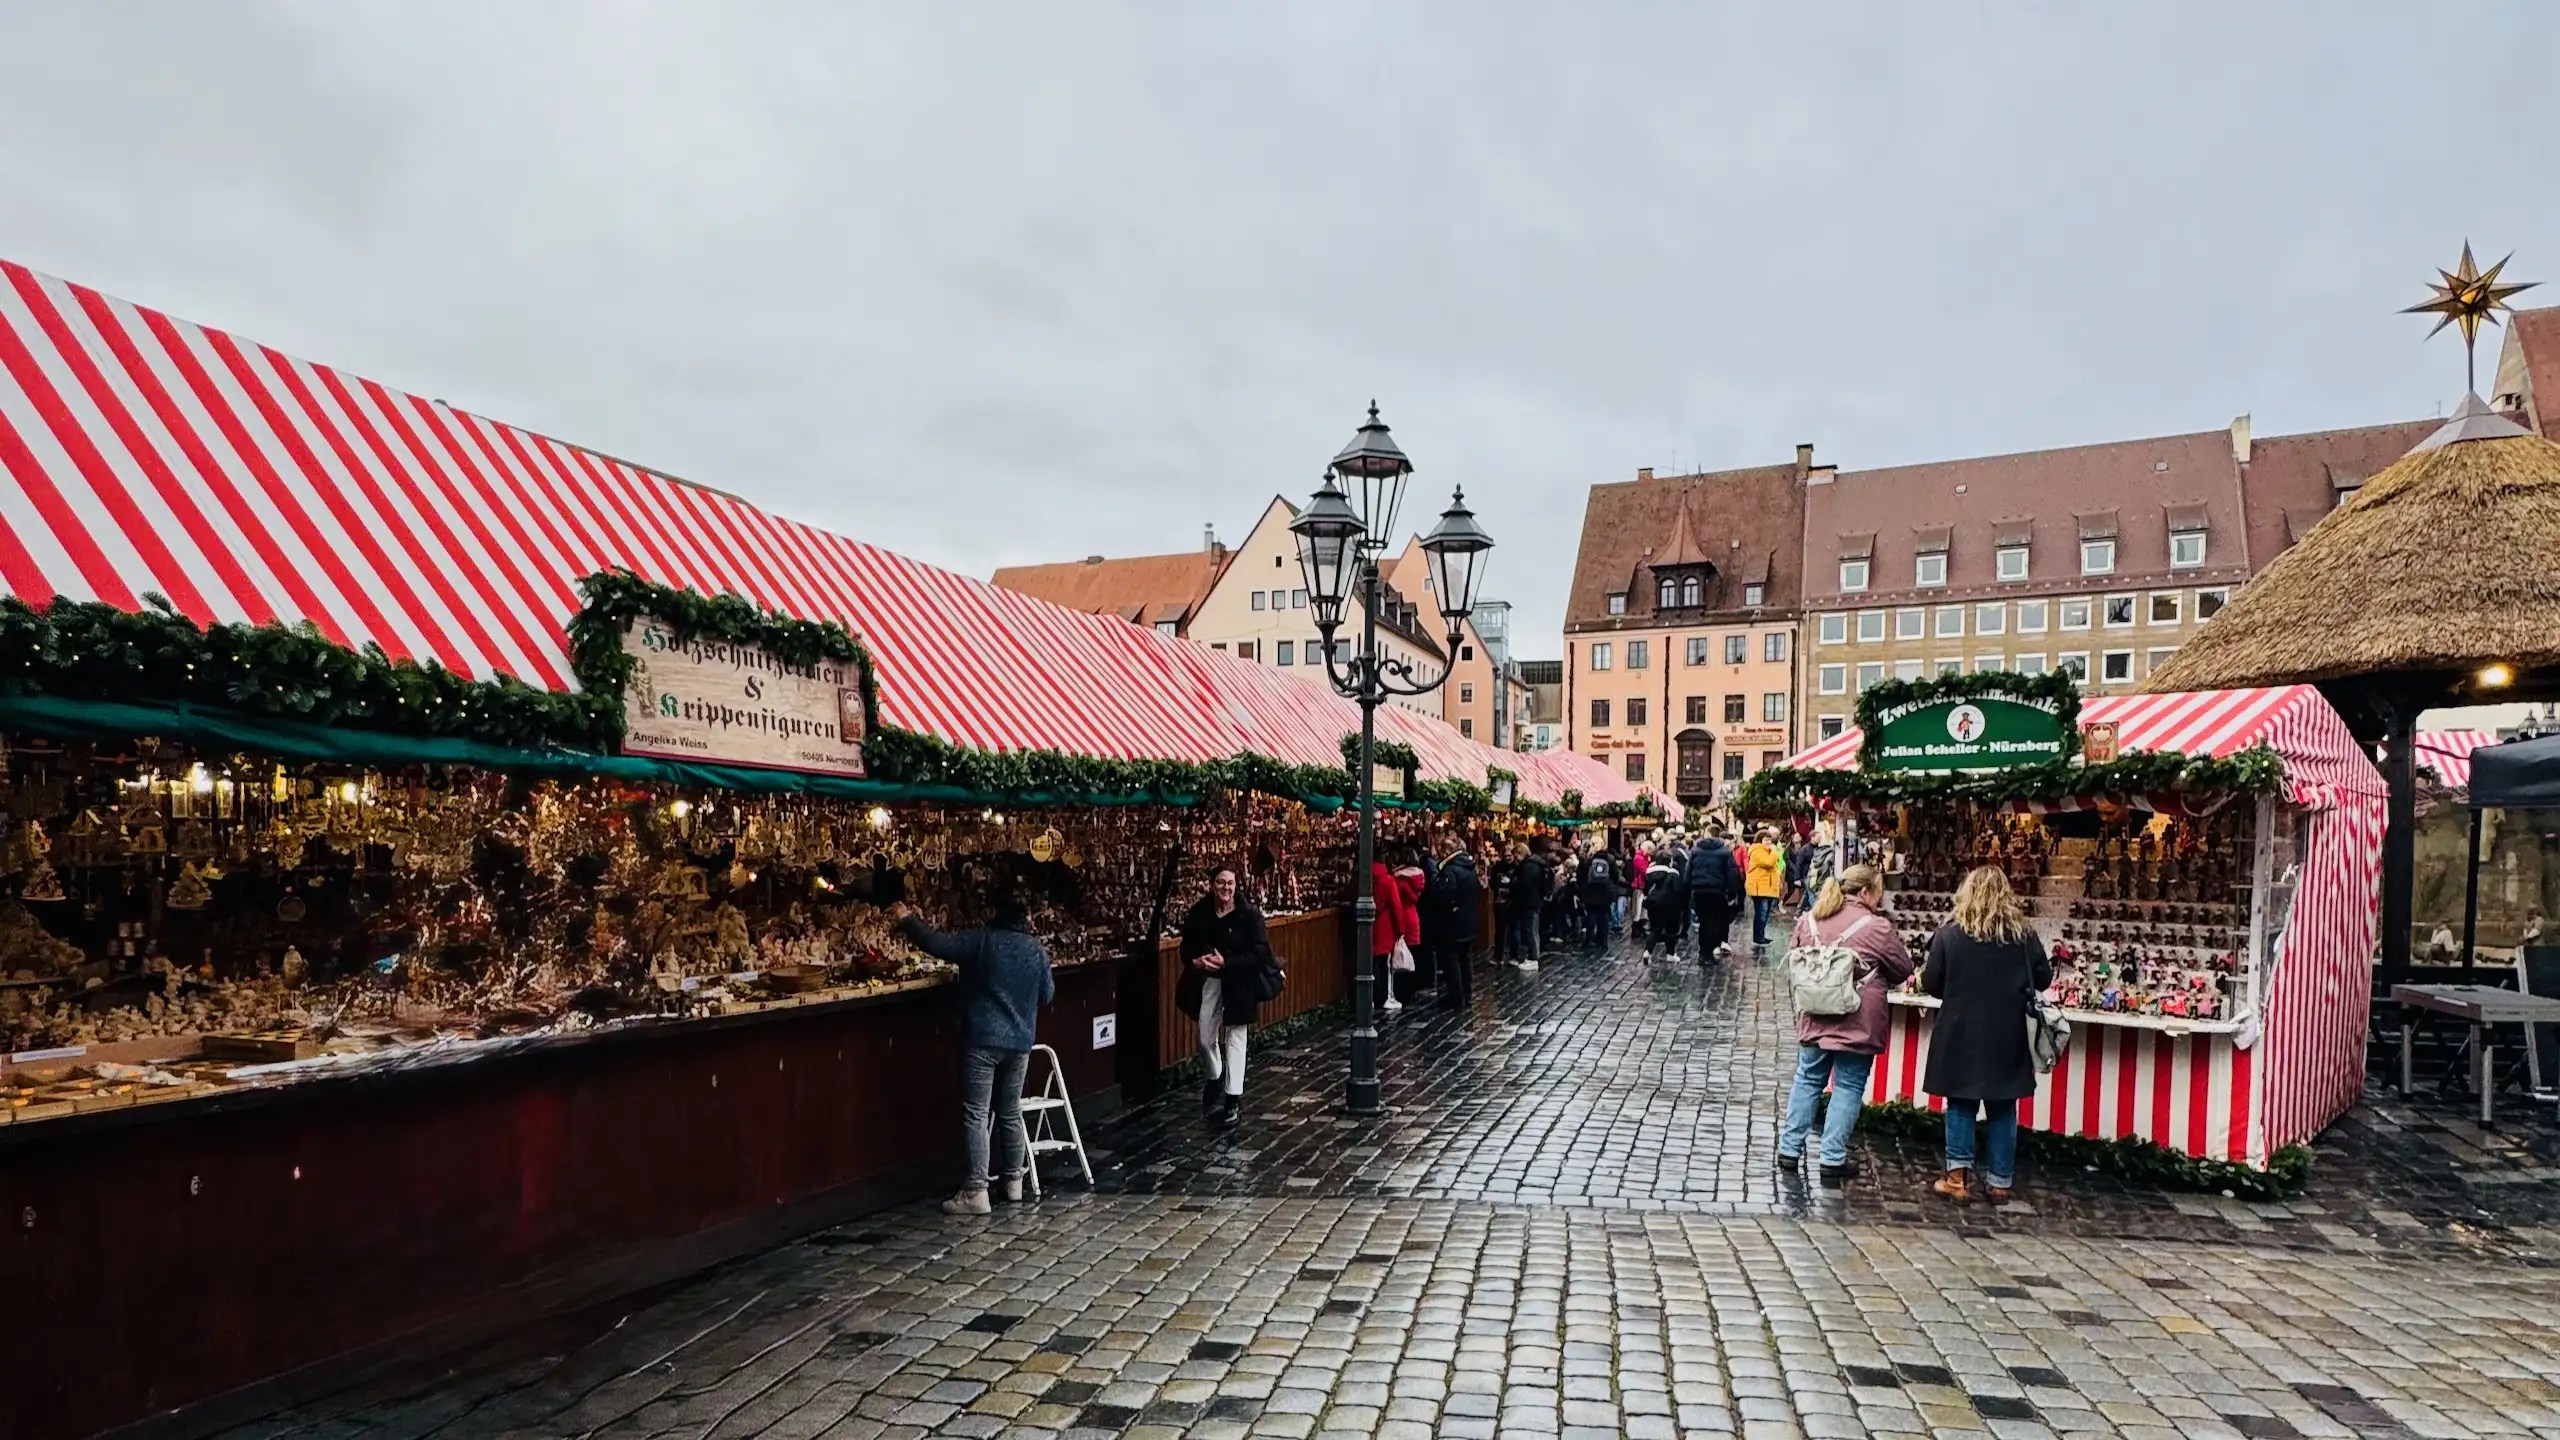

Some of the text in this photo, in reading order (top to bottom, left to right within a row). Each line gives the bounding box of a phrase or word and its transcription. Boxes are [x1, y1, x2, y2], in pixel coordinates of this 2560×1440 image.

[744, 675, 765, 701] &
[660, 692, 836, 741] Krippenfiguren
[633, 731, 708, 749] Angelika Weiss
[1882, 745, 1922, 757] Julian
[1925, 743, 1980, 756] Scheller
[1989, 740, 2060, 753] Nürnberg
